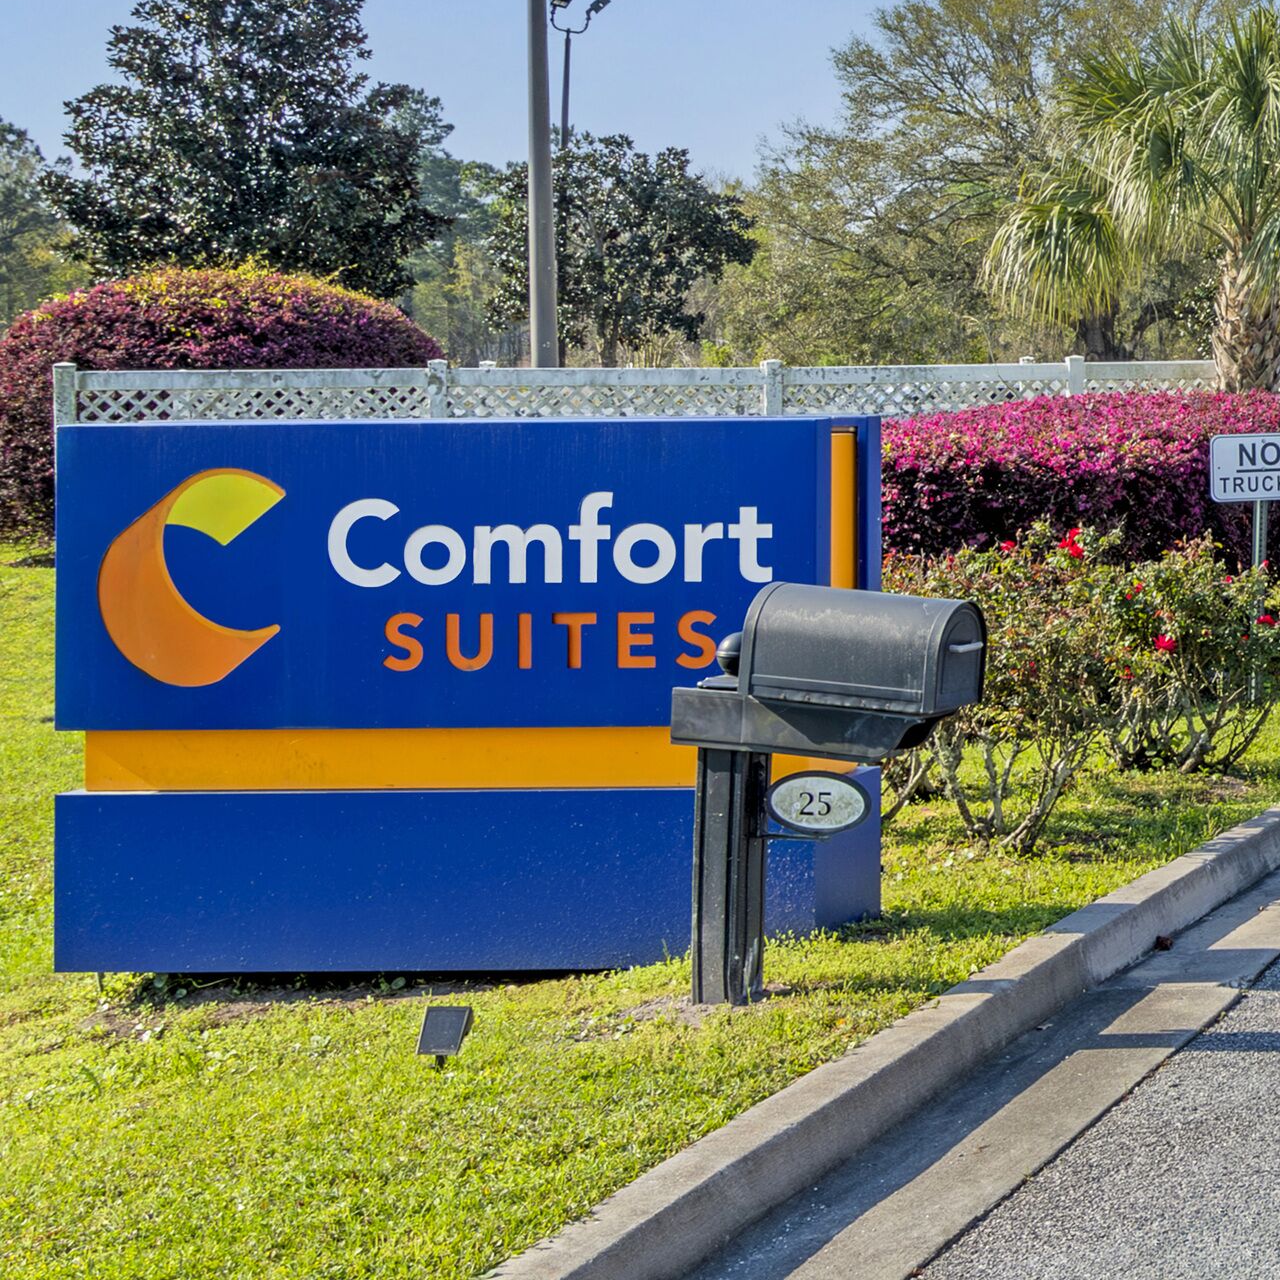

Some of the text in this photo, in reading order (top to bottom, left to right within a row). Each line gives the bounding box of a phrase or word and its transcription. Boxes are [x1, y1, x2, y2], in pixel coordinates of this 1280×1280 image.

[327, 491, 774, 588] Comfort
[382, 609, 718, 672] SUITES
[798, 791, 832, 817] 25
